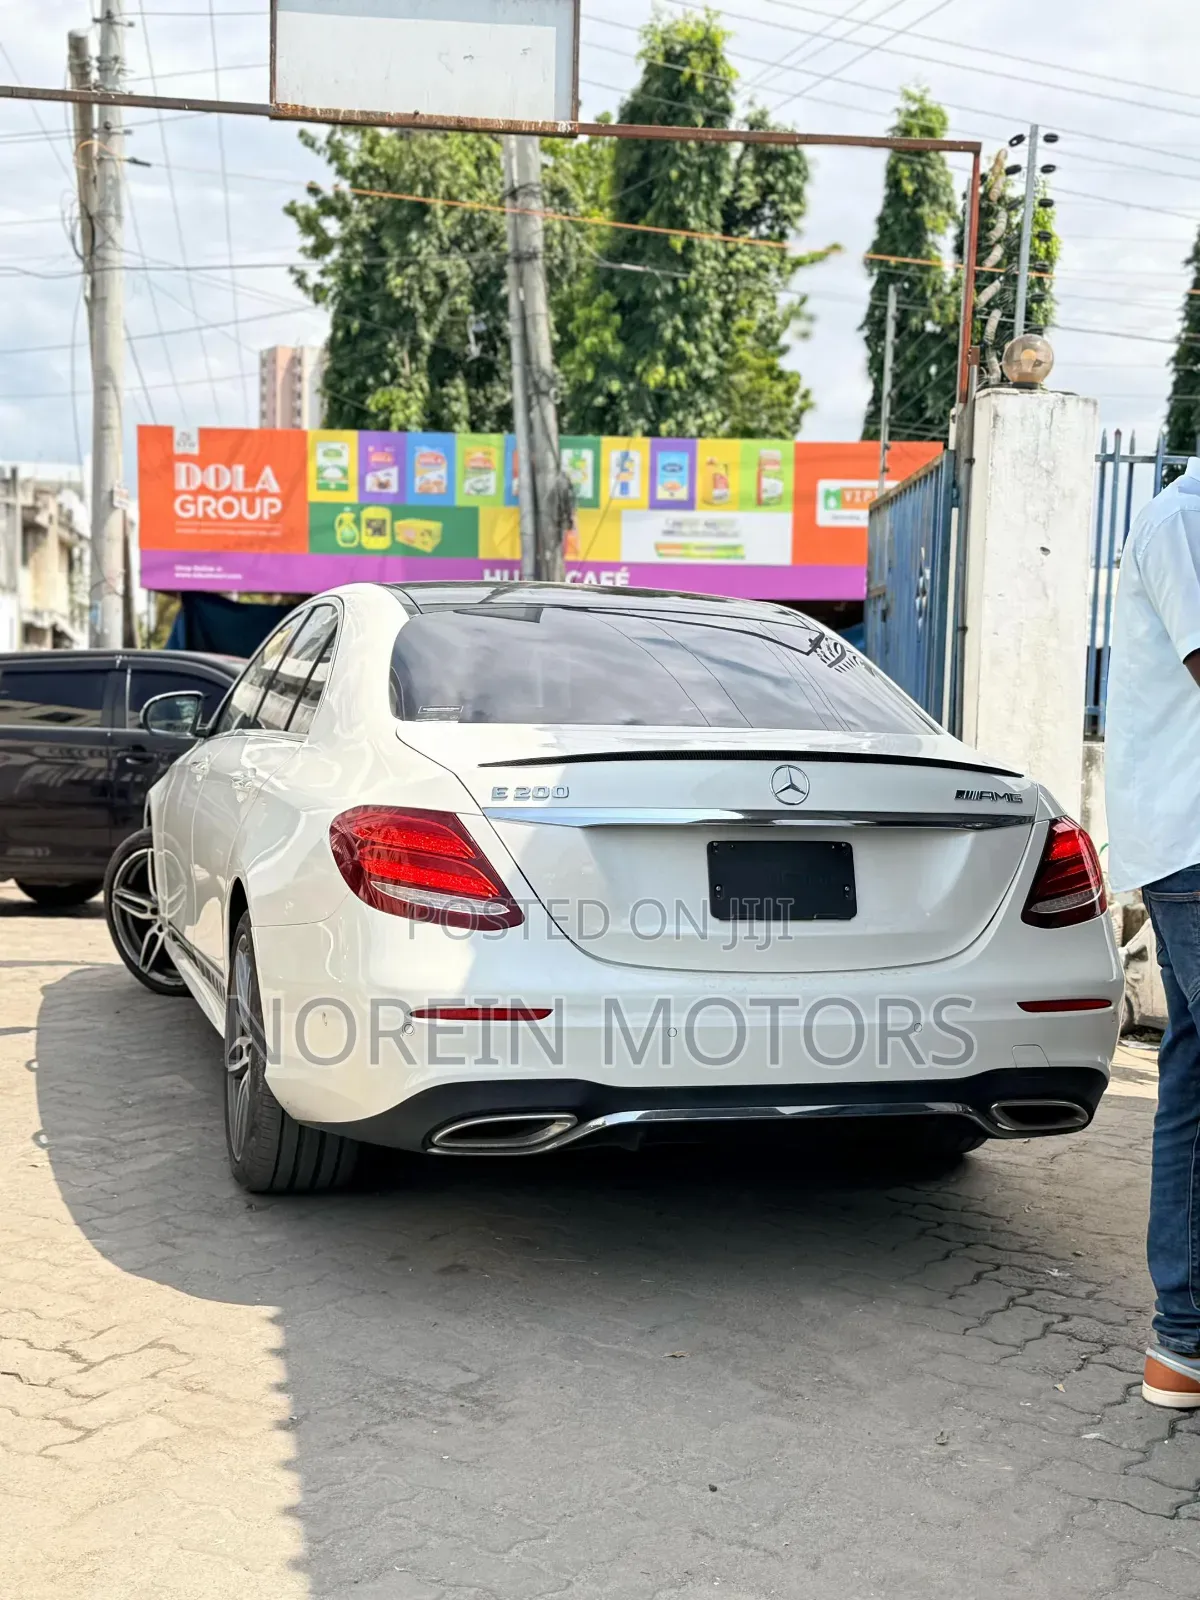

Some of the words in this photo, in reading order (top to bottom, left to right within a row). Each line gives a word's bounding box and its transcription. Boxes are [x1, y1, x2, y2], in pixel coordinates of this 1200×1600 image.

[174, 461, 281, 493] DOLA
[174, 494, 282, 520] GROUP
[491, 786, 508, 801] E
[513, 785, 570, 801] 200
[979, 790, 1023, 803] AMG
